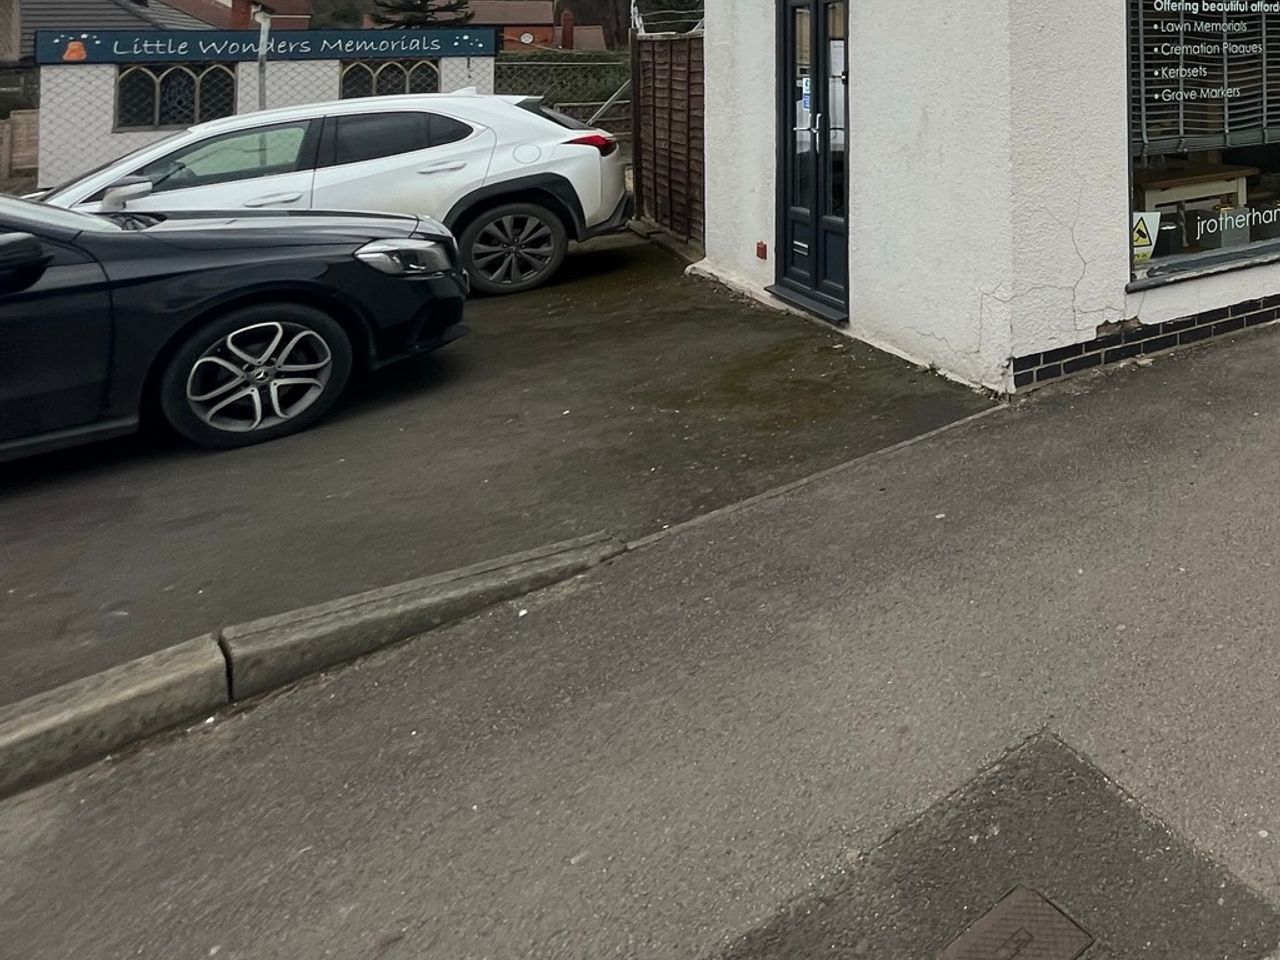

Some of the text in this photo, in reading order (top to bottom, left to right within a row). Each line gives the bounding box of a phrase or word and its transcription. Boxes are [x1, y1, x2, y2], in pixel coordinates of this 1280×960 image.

[1153, 0, 1199, 14] Offering
[1202, 0, 1248, 12] beautiful
[1160, 20, 1247, 33] Lawn Memorials
[113, 36, 441, 55] Little Wonders Memorials
[1160, 41, 1263, 56] Cremation Plaques
[1160, 65, 1208, 79] Kerbsets
[1161, 87, 1241, 102] Grave Markers
